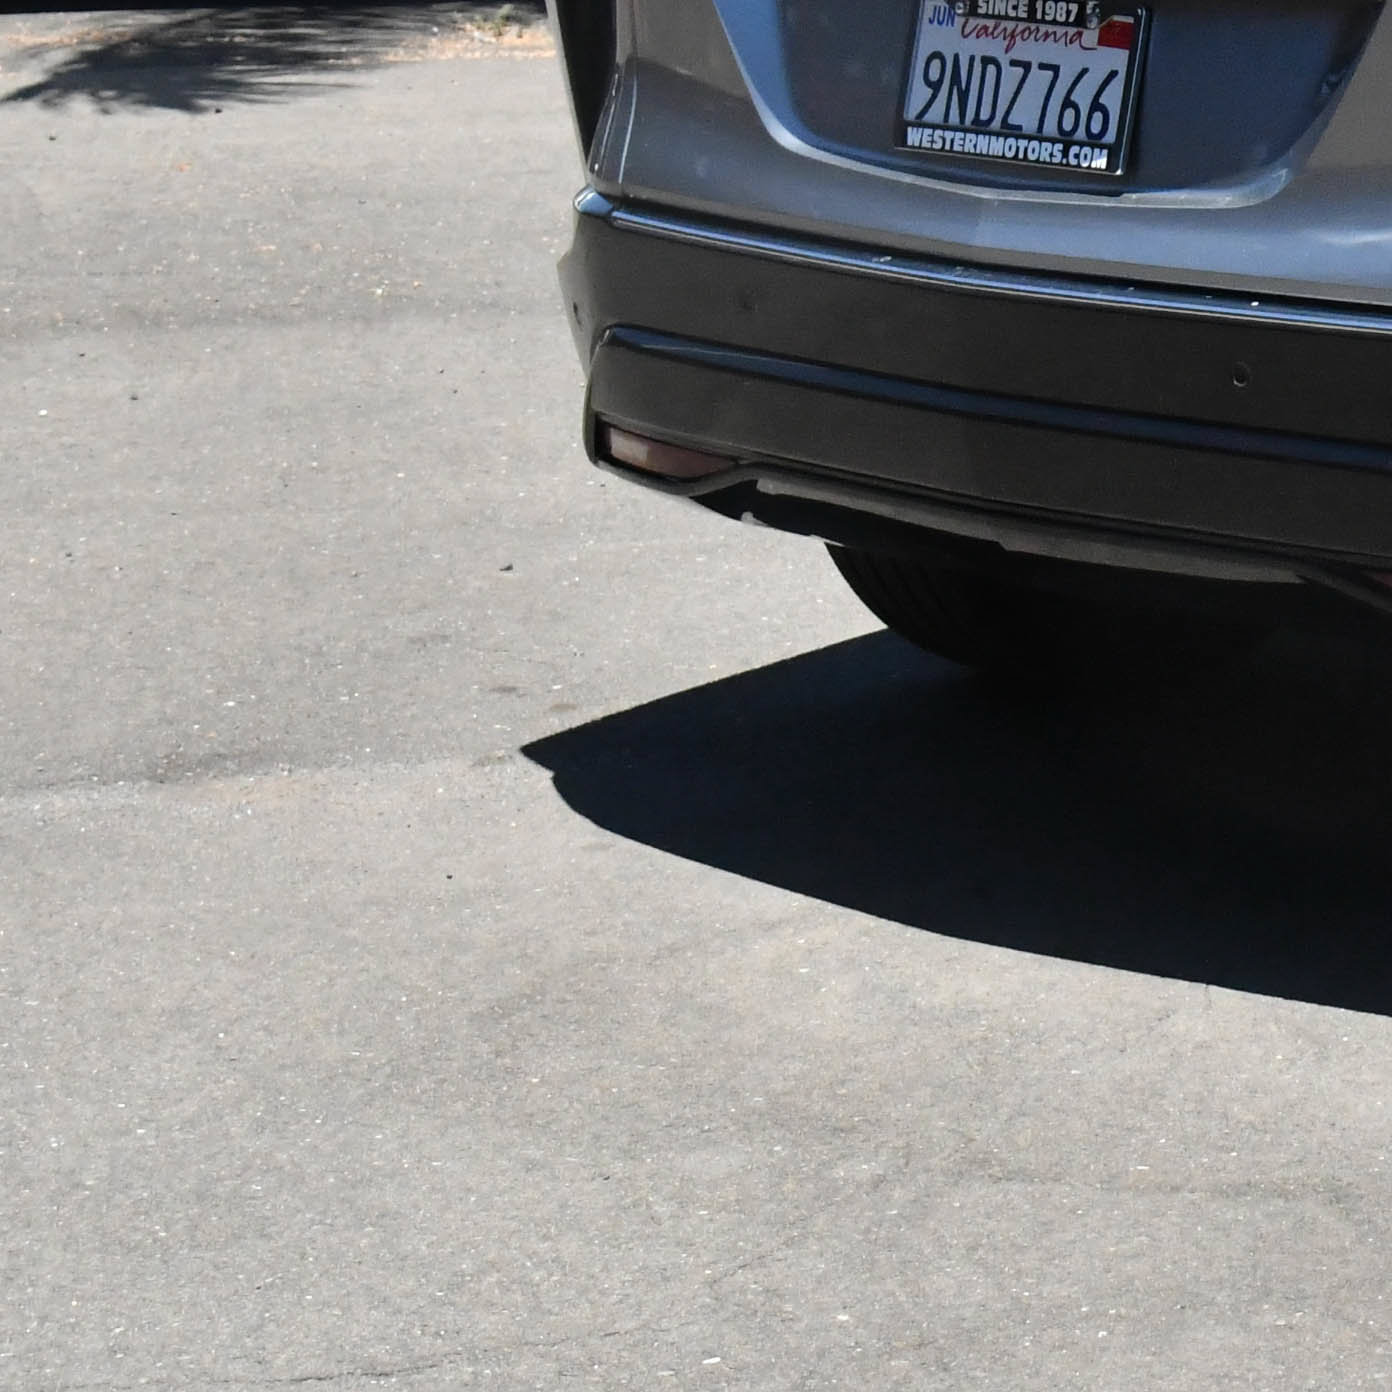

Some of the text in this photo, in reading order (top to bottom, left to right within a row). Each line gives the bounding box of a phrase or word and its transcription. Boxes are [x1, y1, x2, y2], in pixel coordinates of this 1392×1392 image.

[928, 4, 956, 27] JUN
[1035, 0, 1079, 23] 1987
[960, 18, 1097, 53] California
[914, 50, 1119, 141] 9NDZ766
[906, 126, 1108, 170] WESTERNMOTORS.COM
